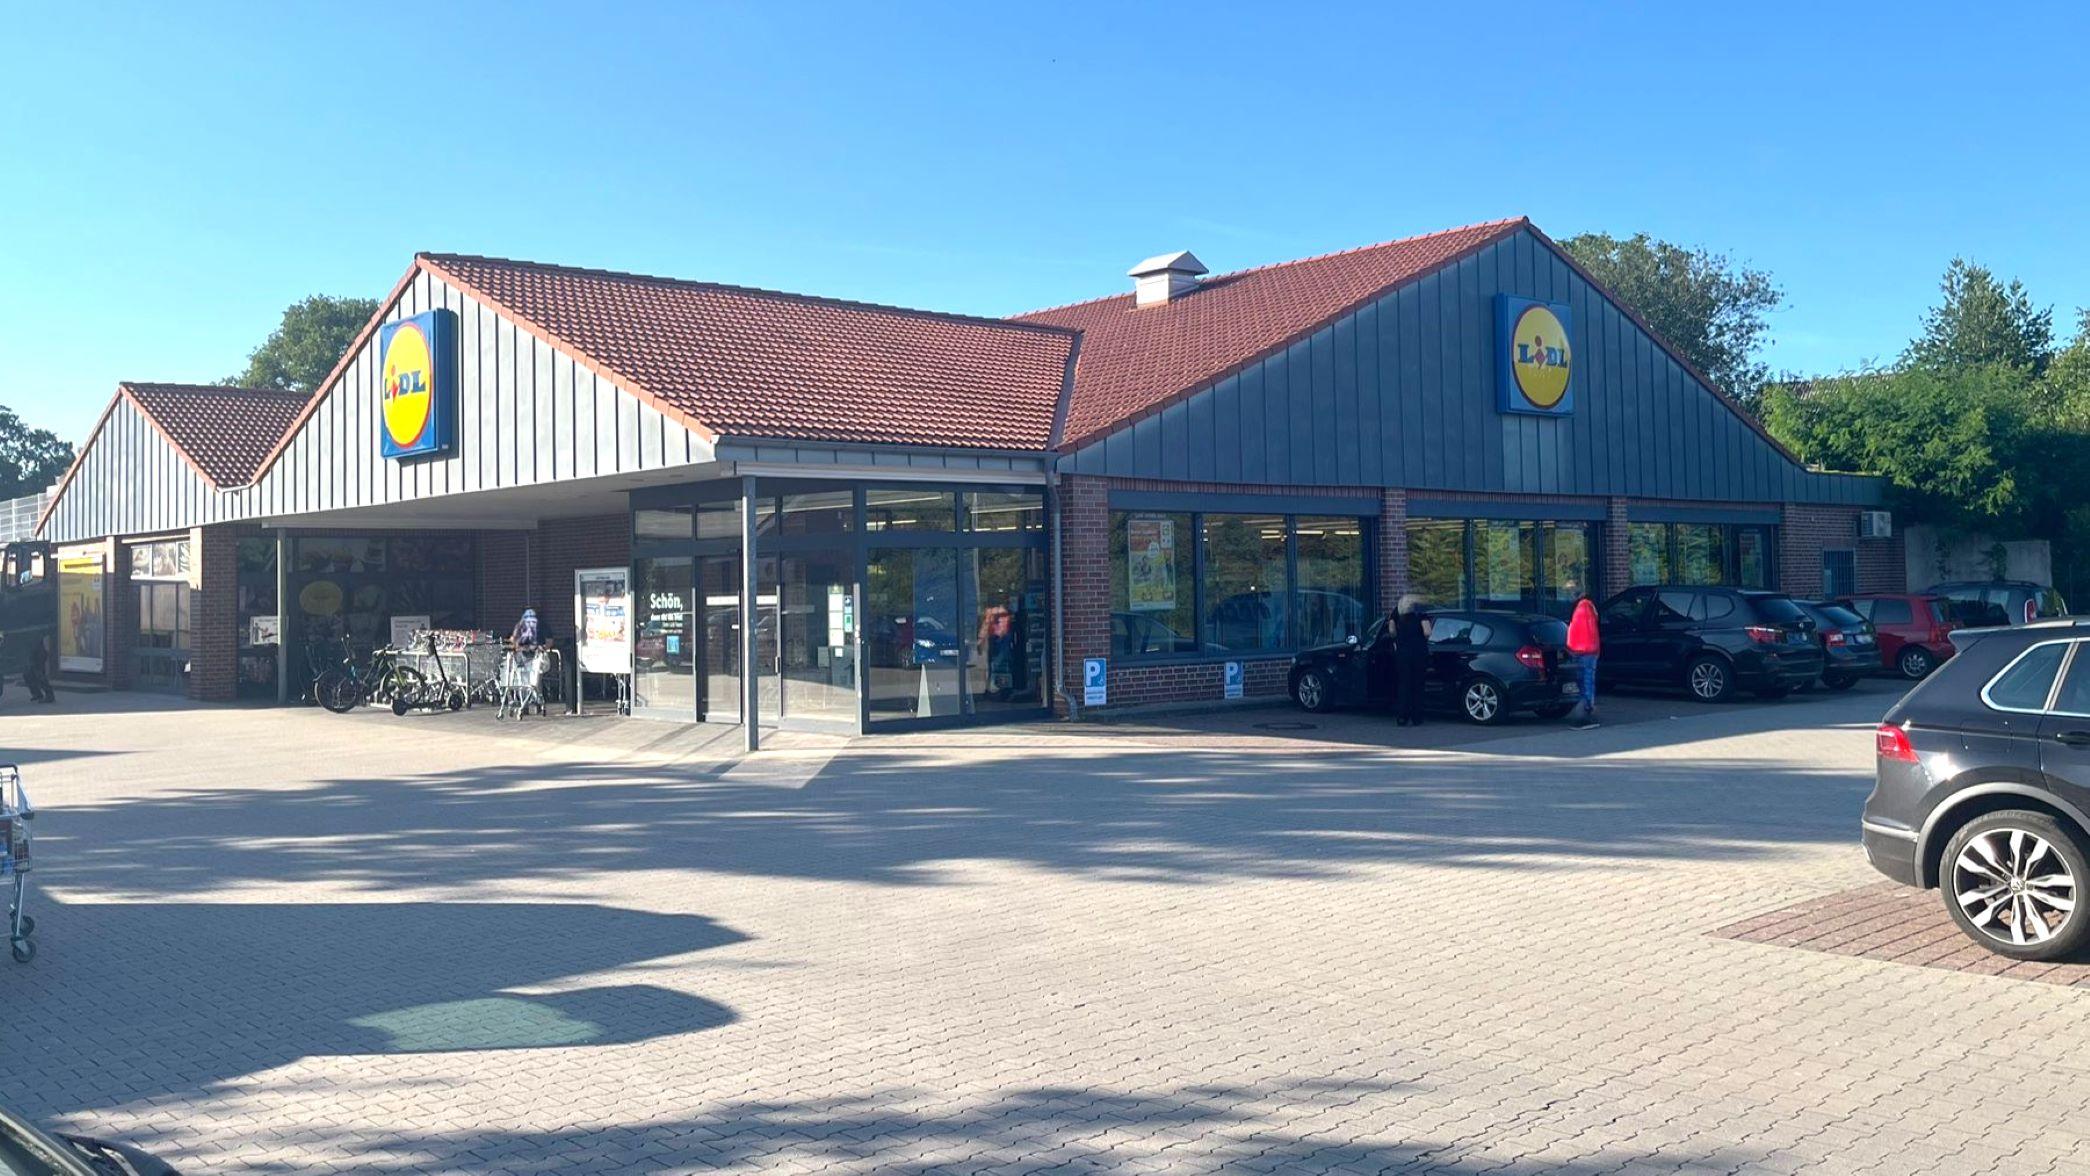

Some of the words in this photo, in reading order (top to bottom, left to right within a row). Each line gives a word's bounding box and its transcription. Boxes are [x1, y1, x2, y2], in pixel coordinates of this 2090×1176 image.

[650, 592, 683, 611] Schön,
[1085, 661, 1101, 686] P
[1225, 662, 1239, 685] P
